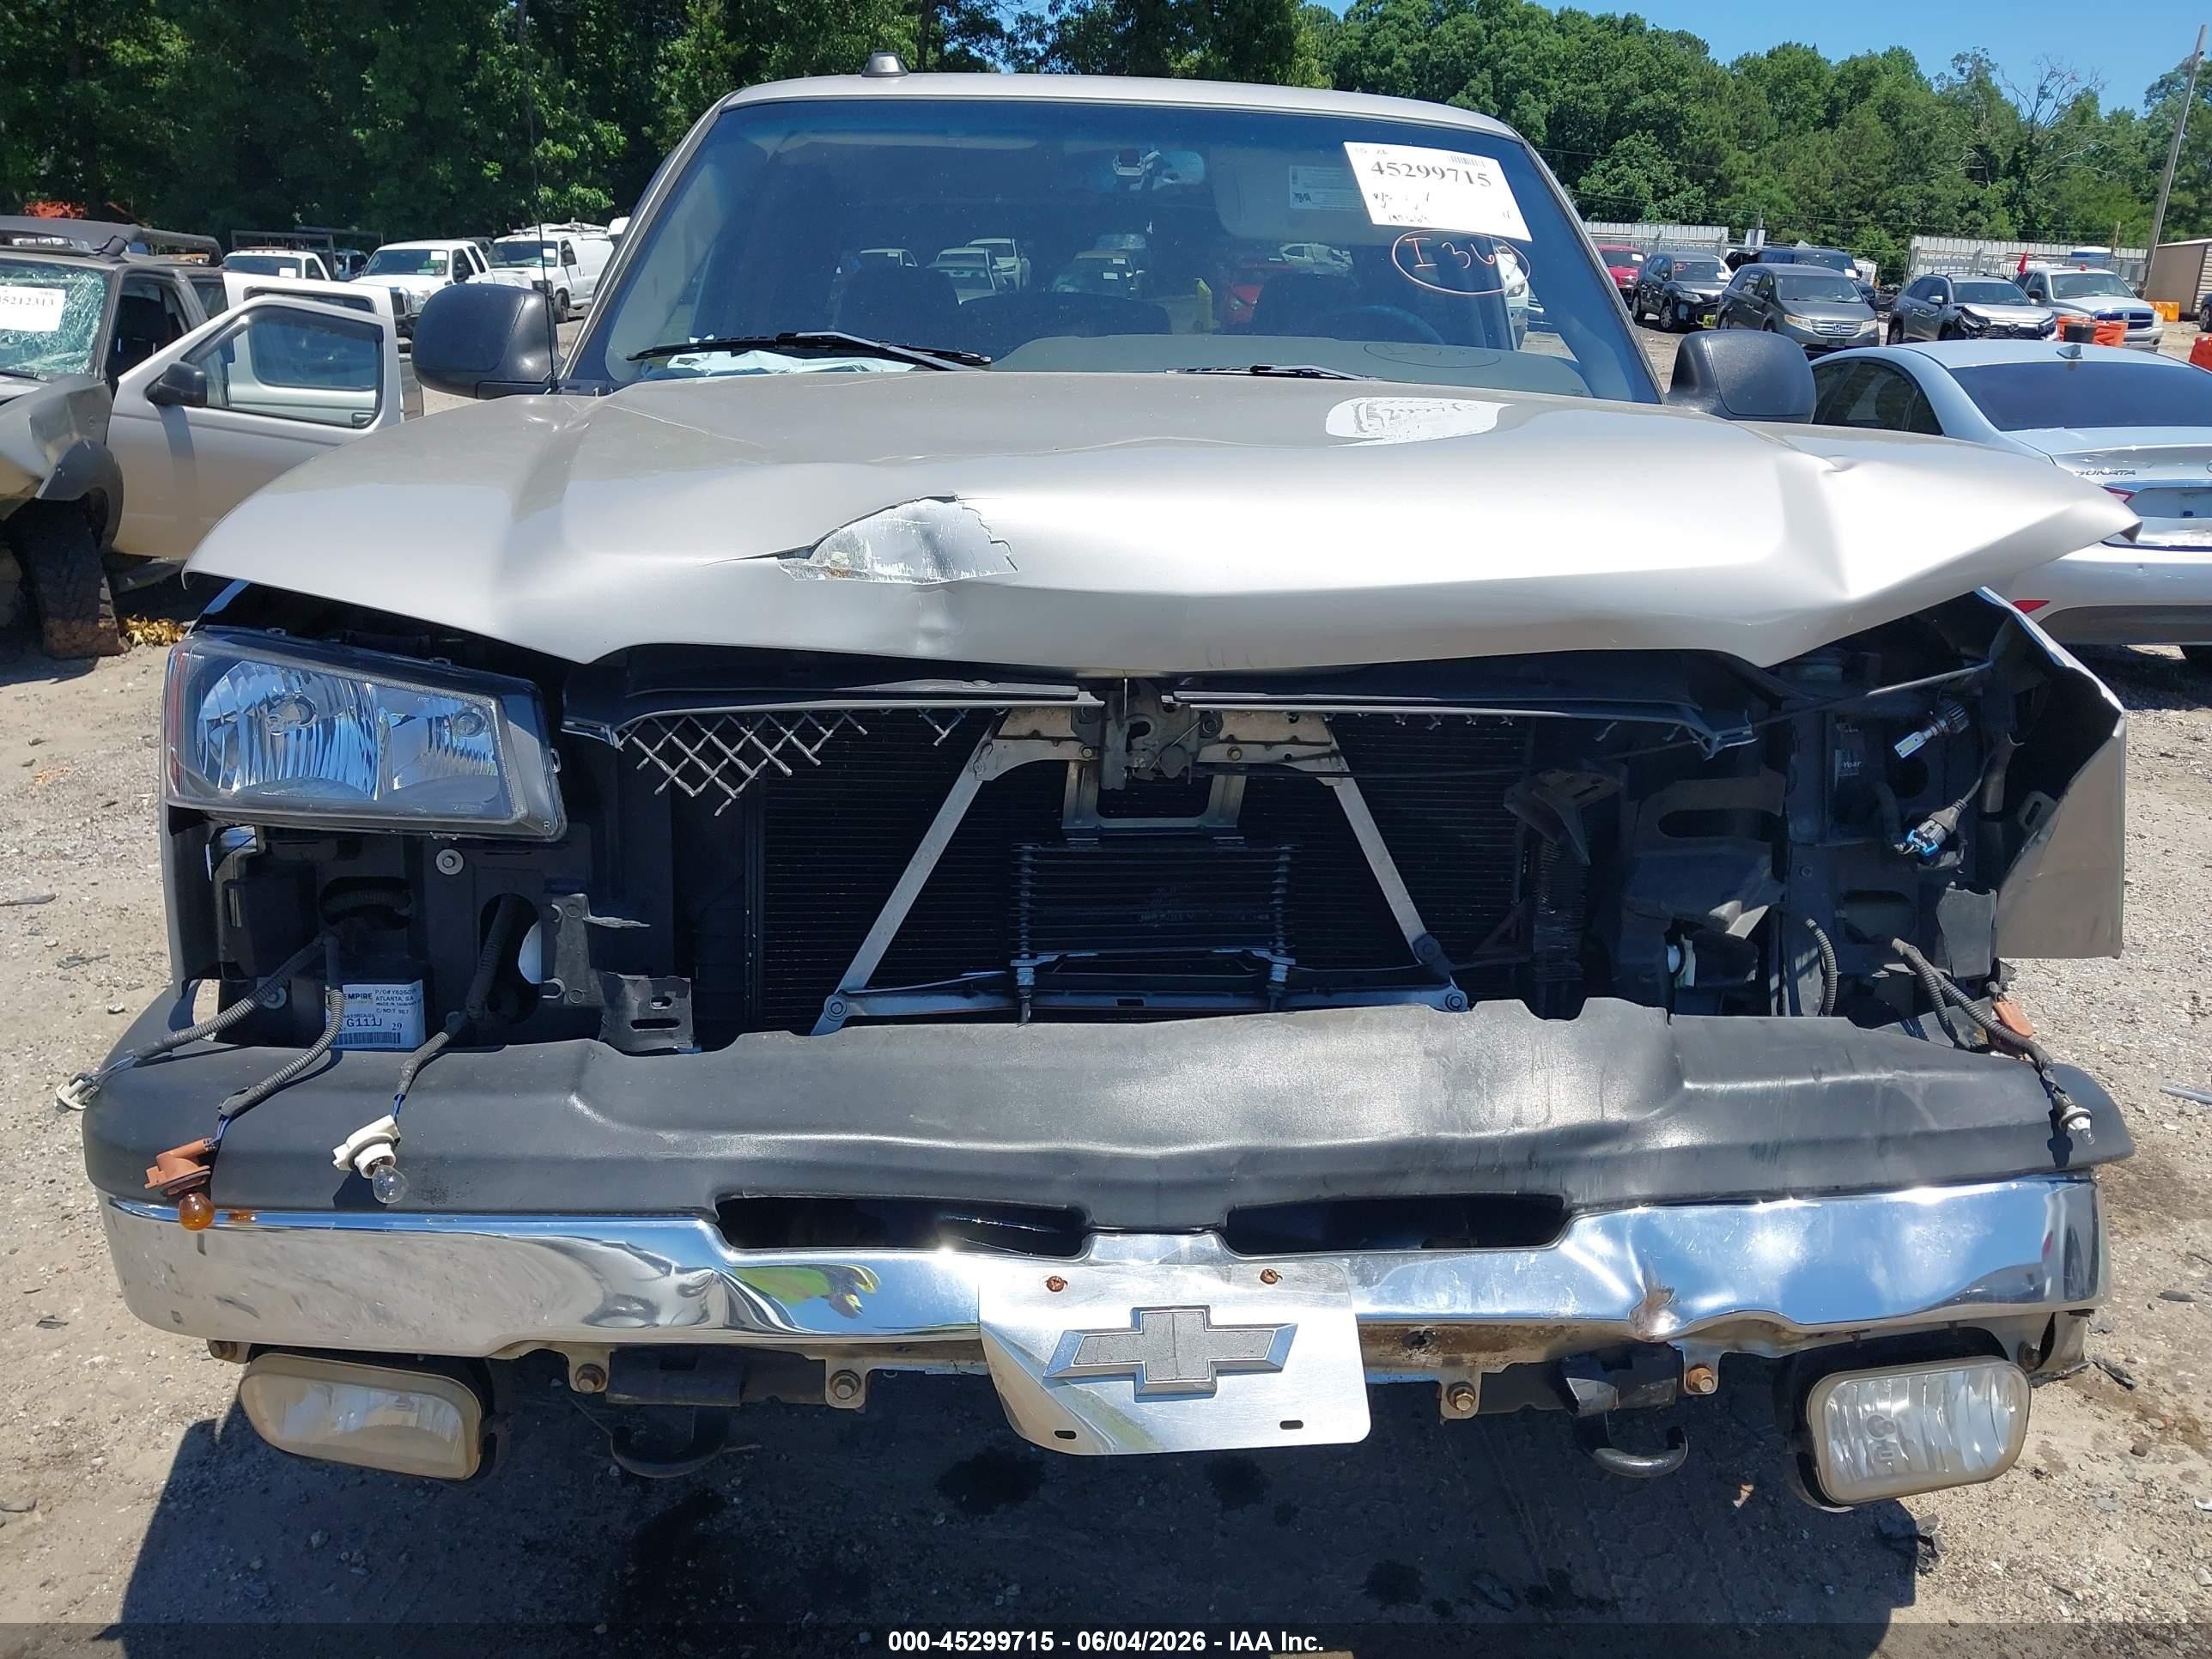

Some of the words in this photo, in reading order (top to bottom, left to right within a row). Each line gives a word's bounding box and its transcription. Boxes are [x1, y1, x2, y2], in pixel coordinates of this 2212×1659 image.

[1370, 161, 1492, 187] 45299715
[0, 295, 54, 307] 5212313
[343, 992, 374, 1000] EMPIRE
[392, 1022, 403, 1030] 29
